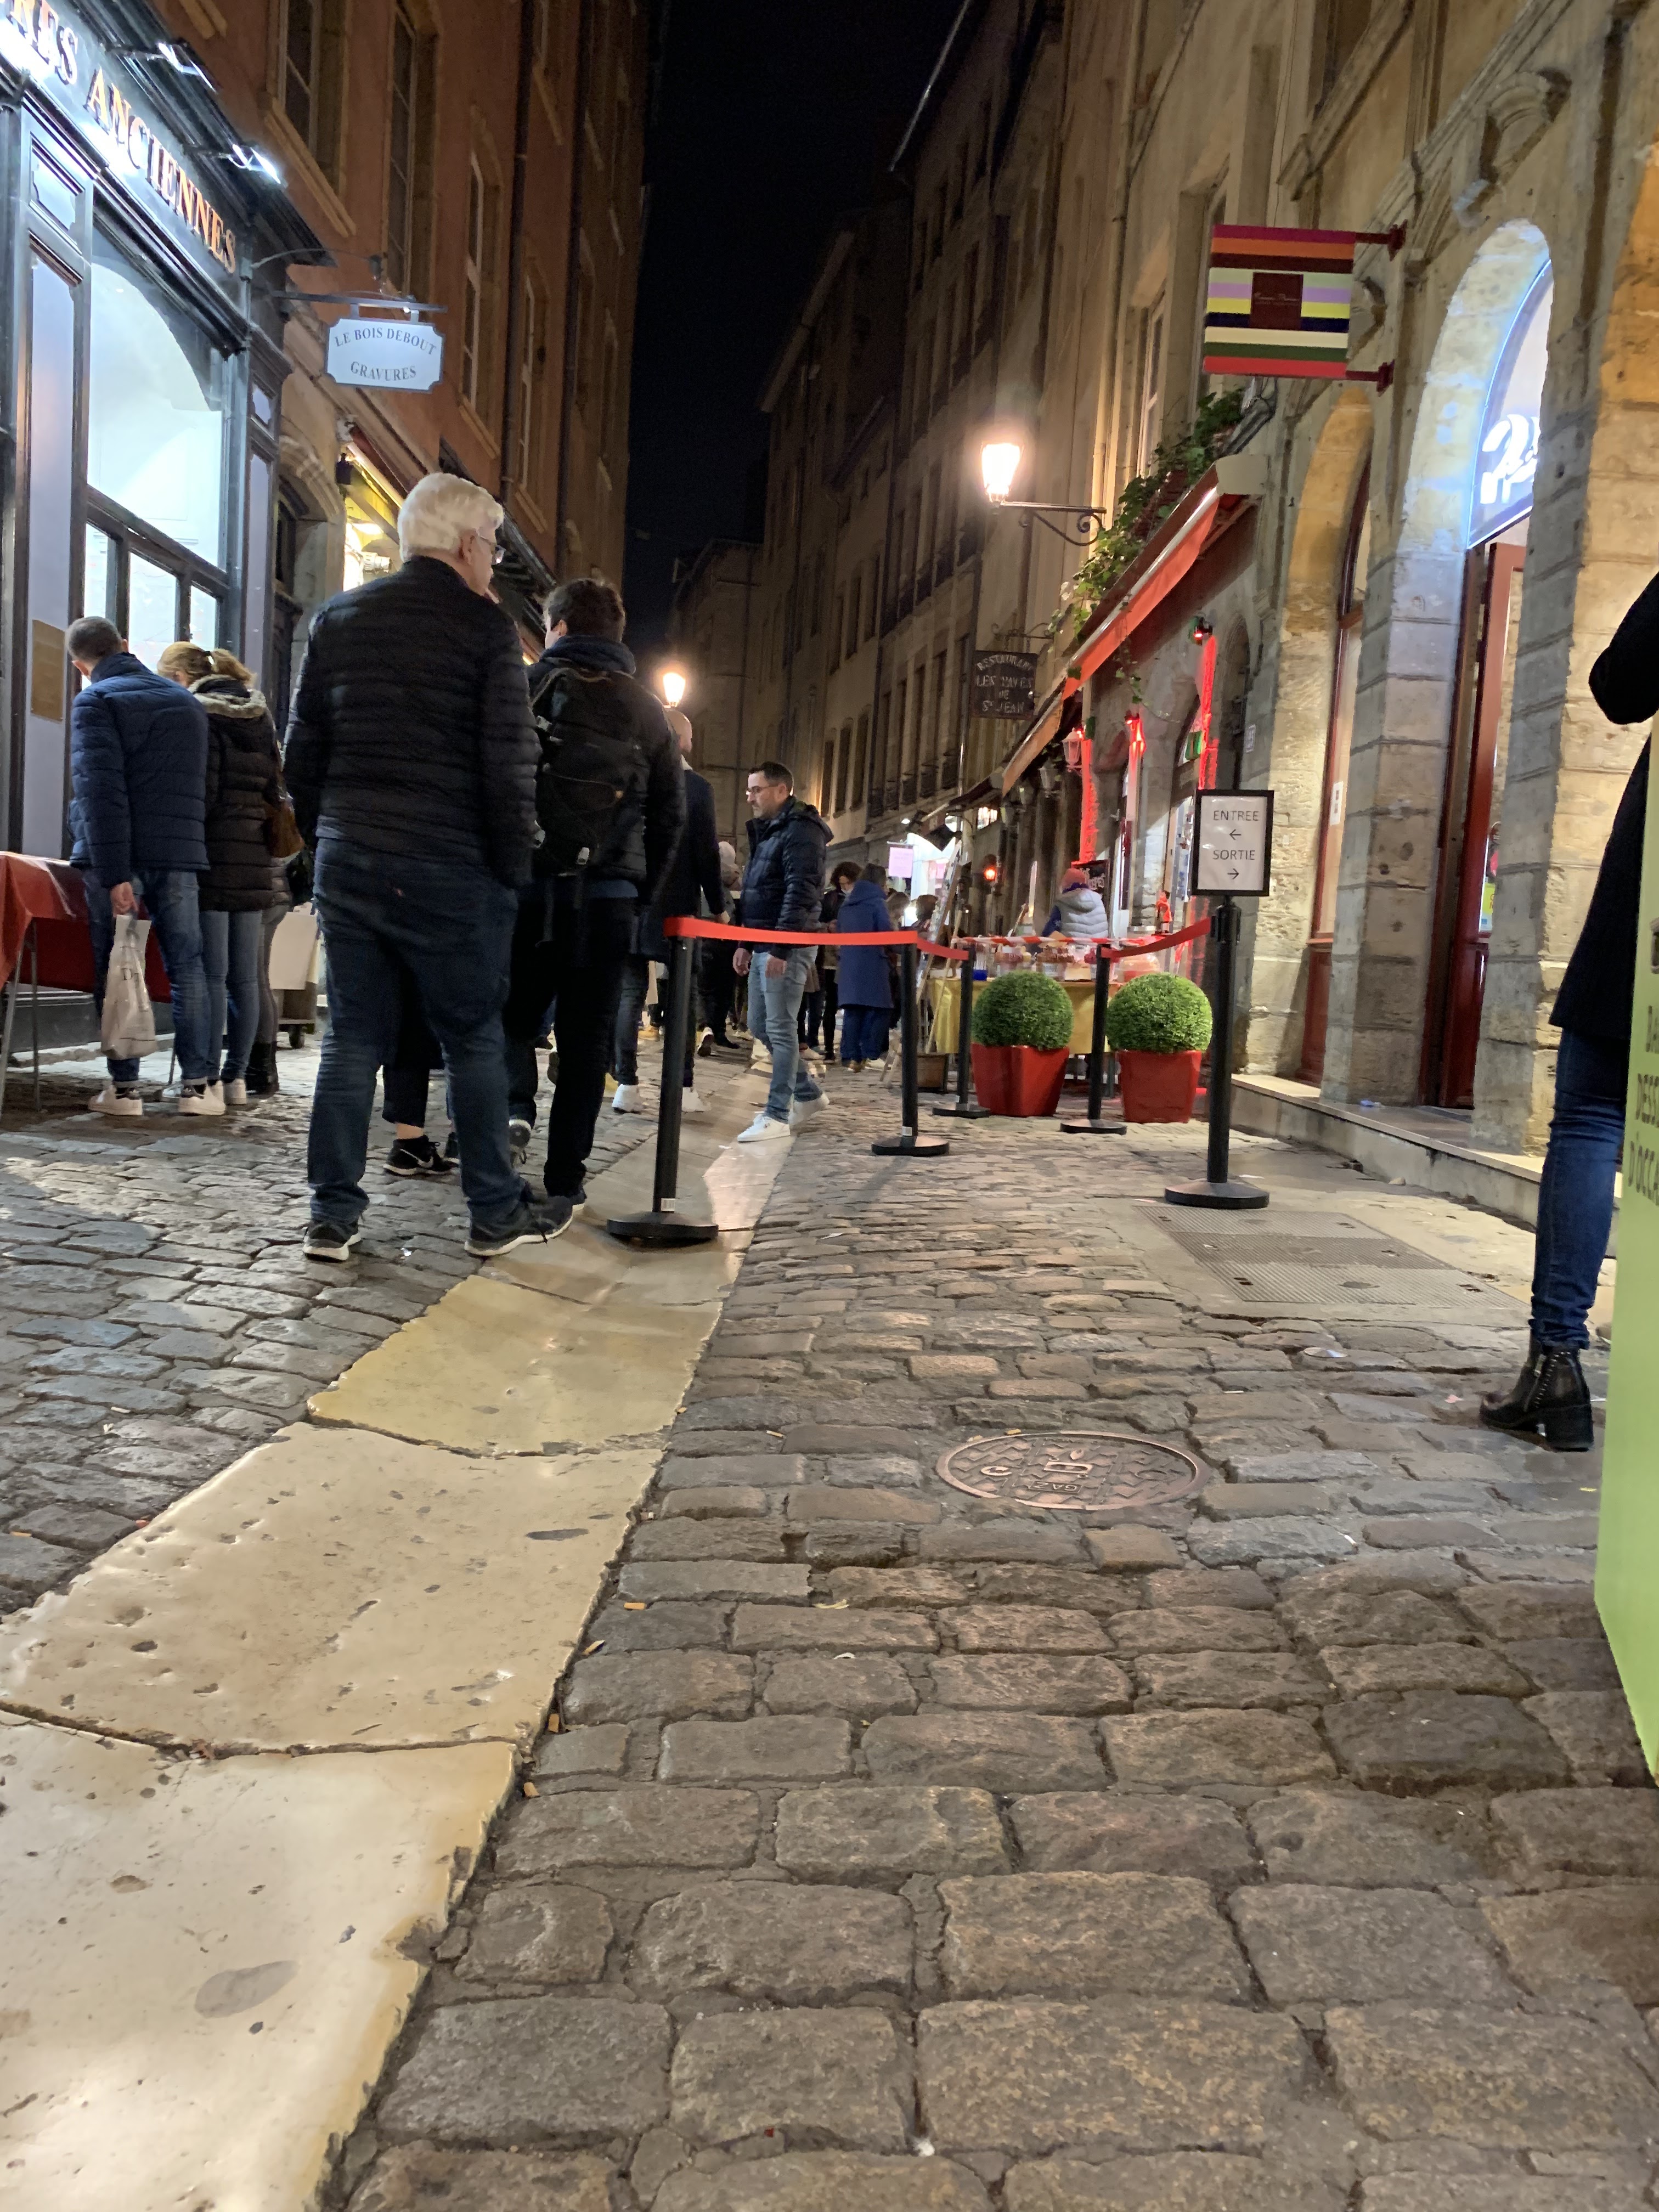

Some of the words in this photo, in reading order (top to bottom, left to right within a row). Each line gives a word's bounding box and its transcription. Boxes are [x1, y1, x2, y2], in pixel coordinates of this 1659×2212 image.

[87, 66, 236, 274] ANCIENNES
[335, 332, 351, 347] LE
[354, 327, 383, 341] BOIS
[387, 328, 437, 355] DEBOUT
[351, 361, 416, 381] GRAVURES
[977, 675, 996, 687] LES
[1213, 810, 1260, 822] ENTREE
[1213, 850, 1256, 861] SORTIE
[1033, 1481, 1077, 1492] GAZ
